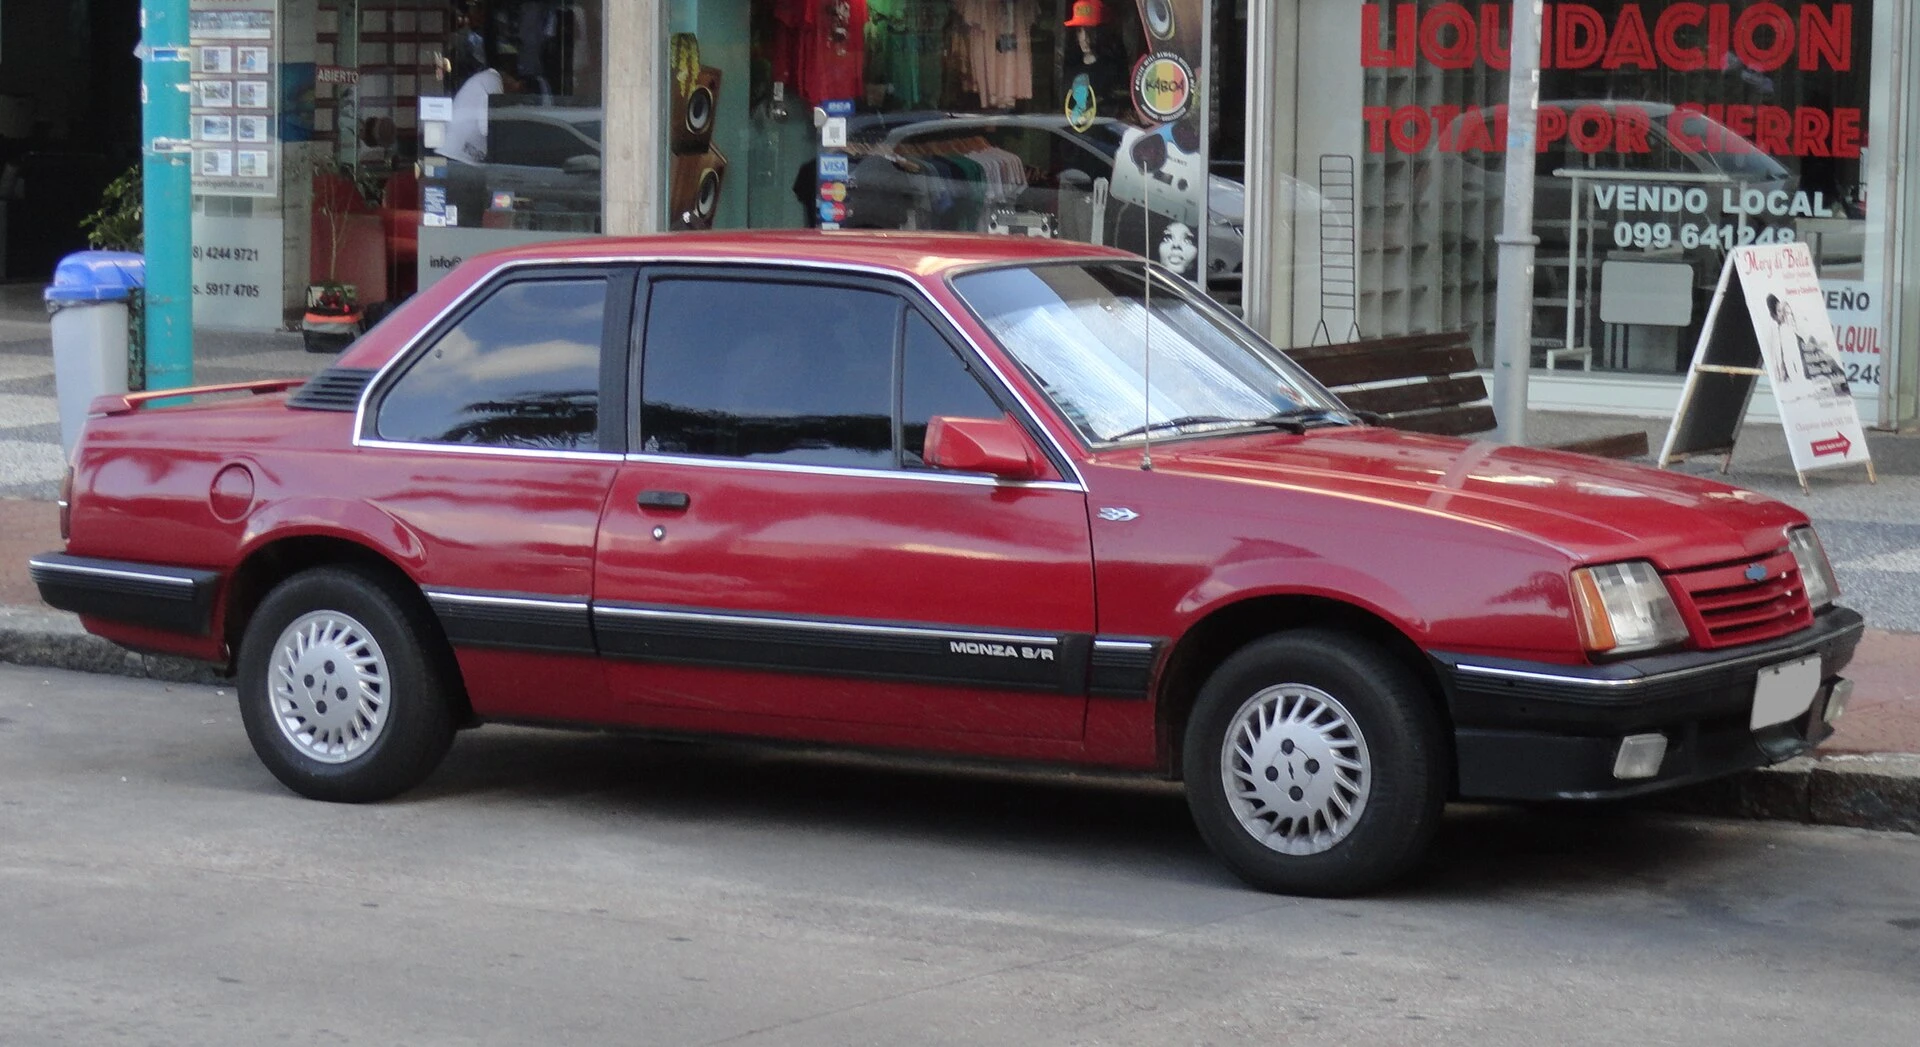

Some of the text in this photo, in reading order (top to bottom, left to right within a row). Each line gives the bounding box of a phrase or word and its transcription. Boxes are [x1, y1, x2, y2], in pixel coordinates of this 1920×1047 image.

[1361, 2, 1852, 72] LIQUIDACION
[317, 68, 359, 83] ABIERTO
[1536, 104, 1650, 154] POR
[1667, 101, 1861, 159] CIERRE
[823, 161, 847, 172] VISA
[1593, 185, 1833, 217] VENDO LOCAL
[1613, 221, 1795, 250] 099 641248
[206, 247, 230, 260] 4244
[234, 248, 258, 261] 9721
[205, 282, 230, 296] 5917
[234, 284, 259, 297] 4705
[1822, 287, 1870, 311] EÑO
[1832, 325, 1880, 354] LQUIL
[1842, 362, 1880, 385] 248
[949, 641, 1054, 660] MONZA S/R
